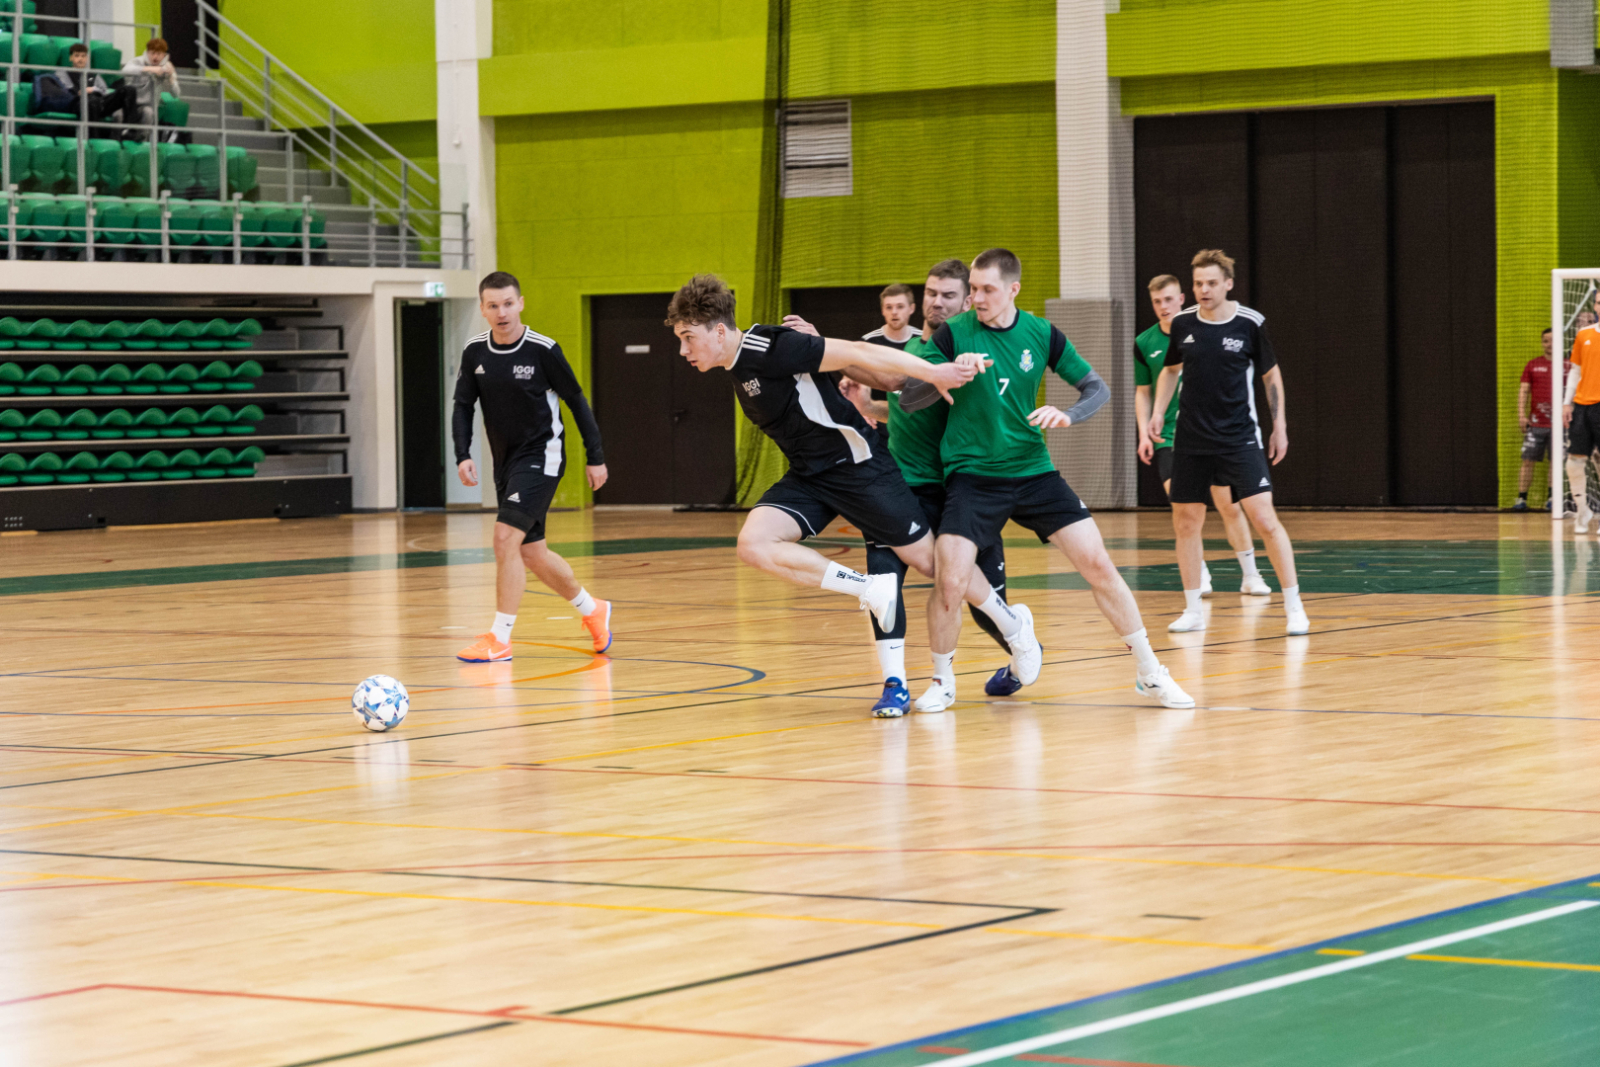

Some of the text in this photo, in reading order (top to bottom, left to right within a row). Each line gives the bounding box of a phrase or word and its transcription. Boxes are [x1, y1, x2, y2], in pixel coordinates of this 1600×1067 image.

[513, 365, 535, 375] IGGI
[742, 378, 761, 392] IGGI
[999, 378, 1010, 395] 7
